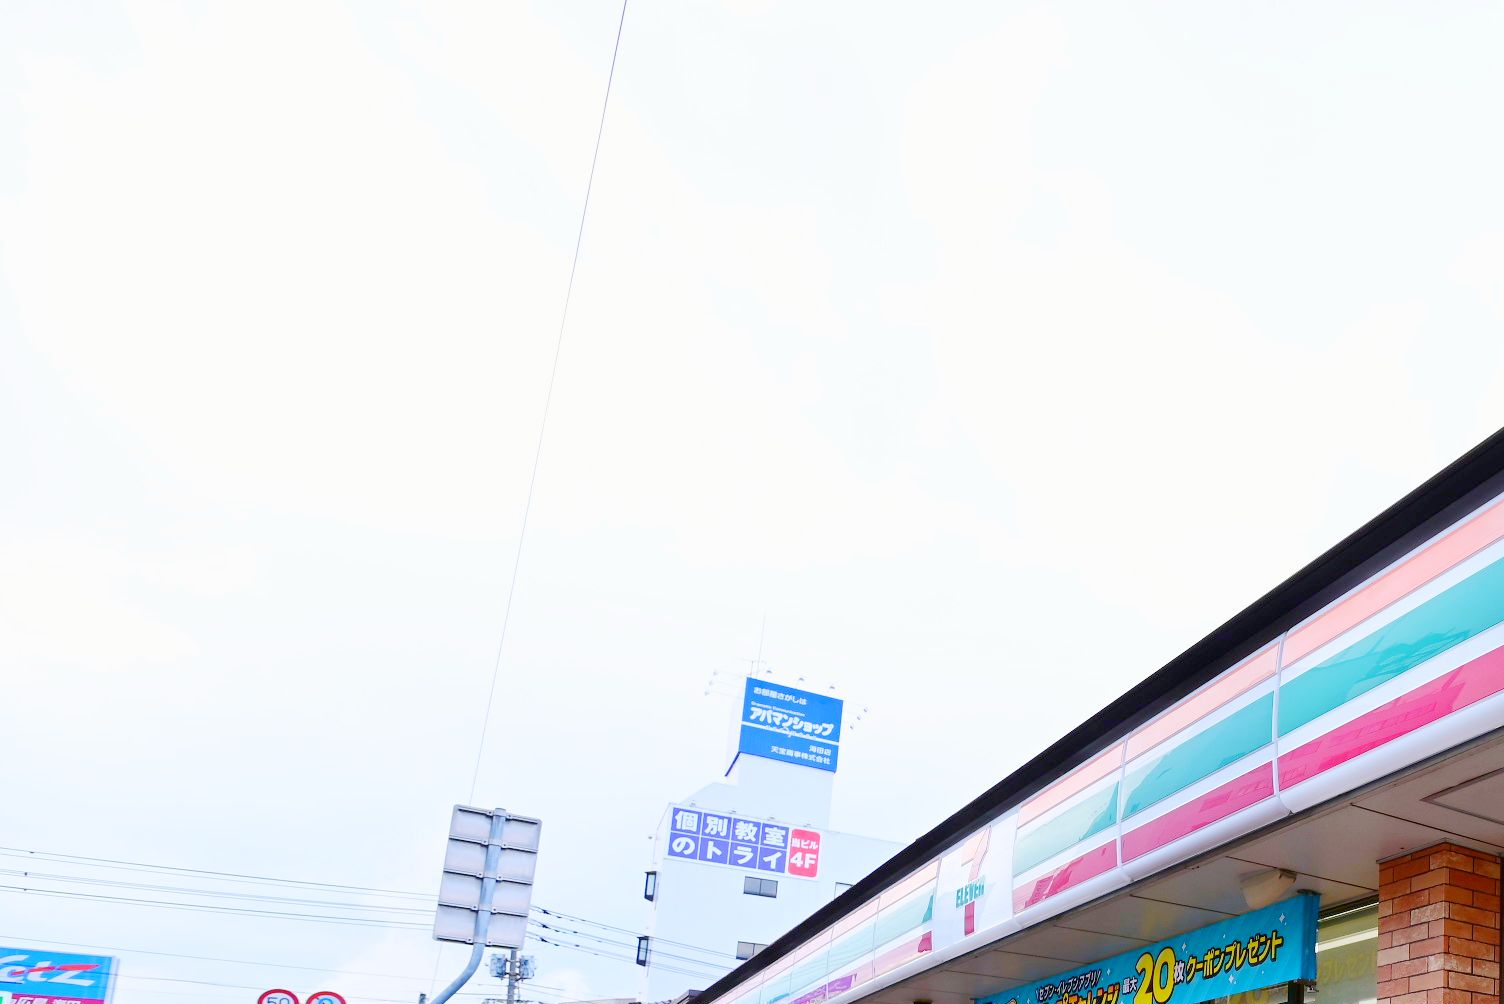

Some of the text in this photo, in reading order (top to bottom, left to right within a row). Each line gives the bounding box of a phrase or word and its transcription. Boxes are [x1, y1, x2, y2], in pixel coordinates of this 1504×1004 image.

[750, 707, 834, 736] アパマンショップ
[675, 810, 786, 847] 個別教室
[791, 838, 819, 850] 当ビル
[672, 836, 783, 870] のトライ
[790, 852, 817, 869] 4F
[1122, 977, 1138, 994] 最大
[1174, 960, 1185, 984] 枚
[1186, 929, 1284, 983] クーポンプレゼント
